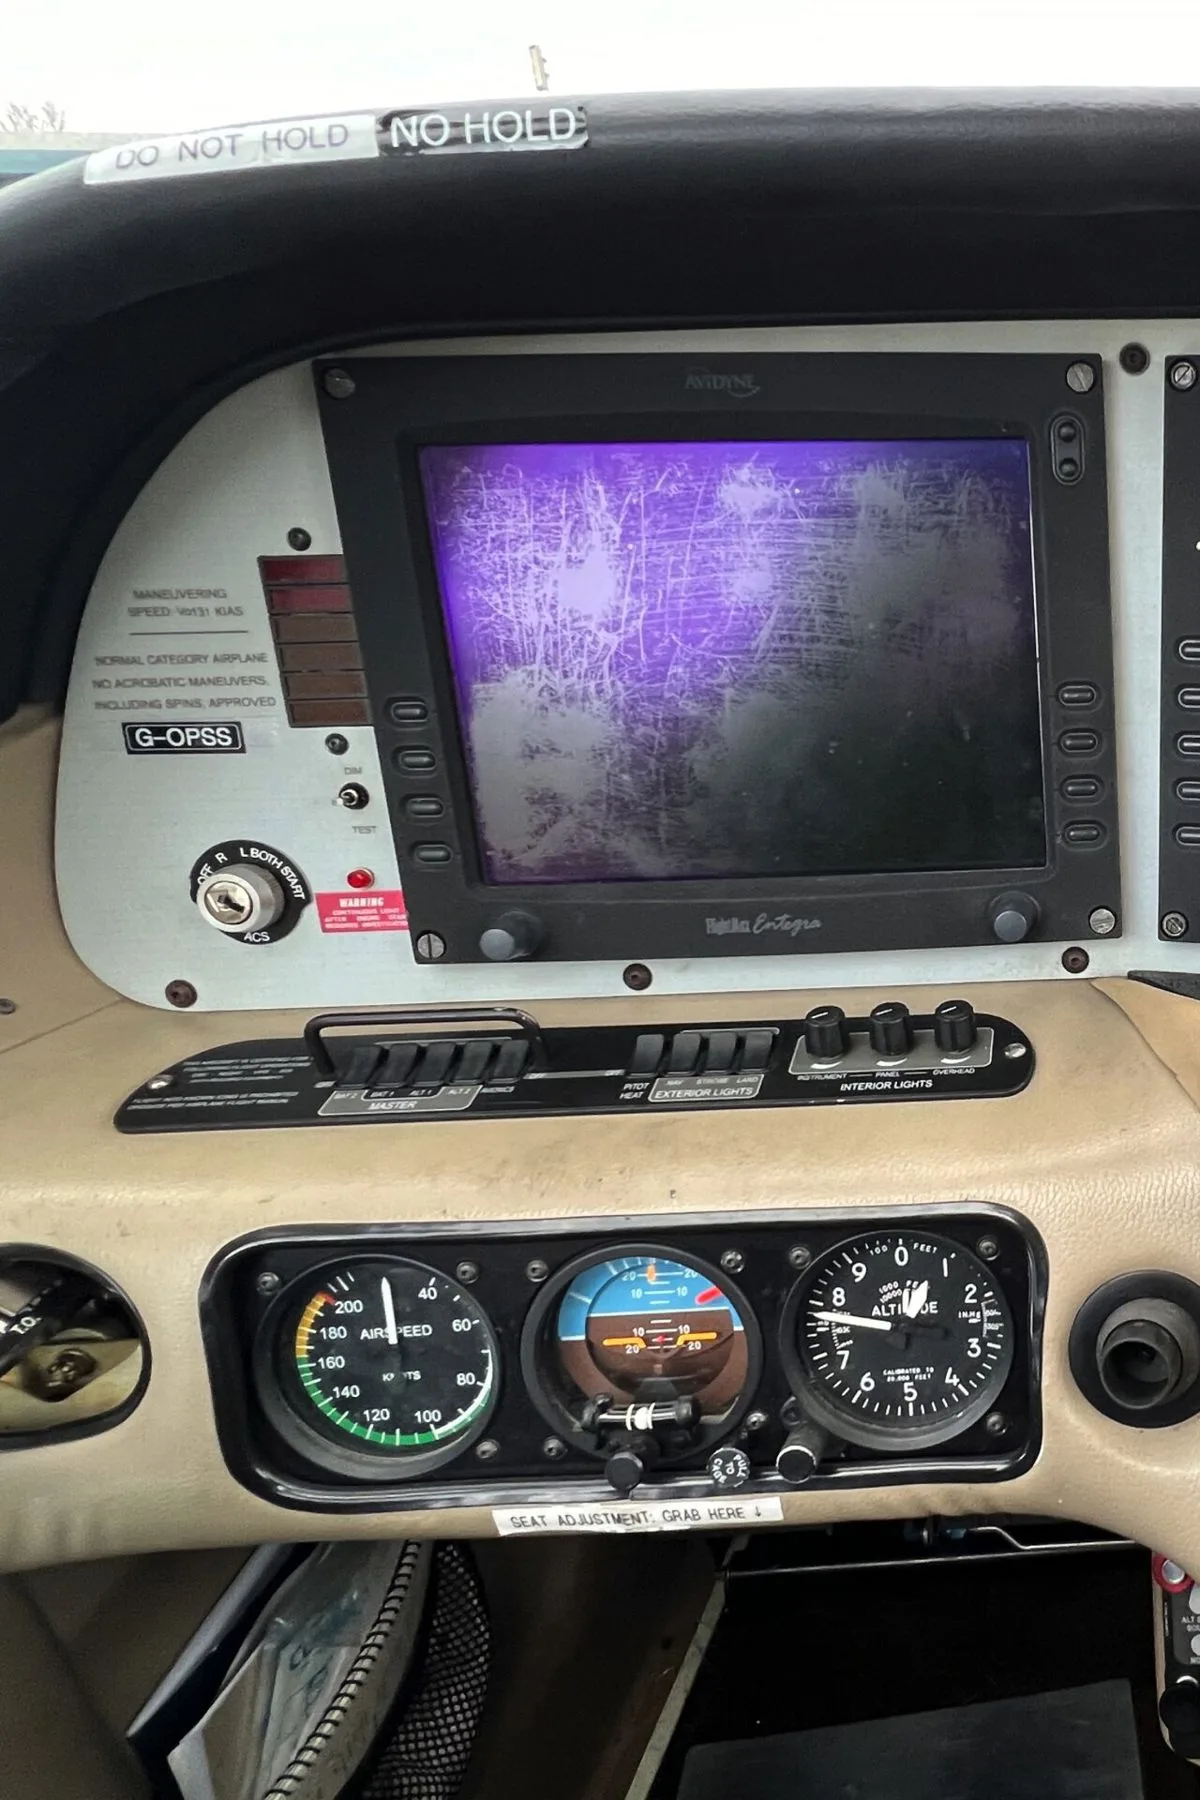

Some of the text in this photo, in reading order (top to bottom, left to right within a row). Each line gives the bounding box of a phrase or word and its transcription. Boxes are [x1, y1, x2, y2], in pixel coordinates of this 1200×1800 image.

[390, 108, 577, 147] NO HOLD
[116, 124, 349, 170] DO NOT HOLD
[685, 374, 755, 390] AVIDYNE
[133, 589, 228, 599] MANEUVERING
[215, 606, 244, 616] KIAS
[94, 653, 268, 666] NORMAL CATEGORY AIRPLANE
[92, 679, 112, 689] NO
[115, 678, 185, 688] ACROBATIC
[94, 700, 162, 710] INCLUDING
[209, 697, 276, 707] APPROVED
[135, 727, 232, 747] G-OPSS
[352, 825, 377, 834] TEST
[250, 847, 283, 870] BOTH
[280, 865, 306, 900] START
[339, 897, 384, 907] WARNING
[244, 931, 270, 942] ACS
[797, 1073, 847, 1081] INSTRUMENT
[840, 1079, 933, 1091] INTERIOR LIGHTS
[619, 1092, 644, 1100] HEAT
[655, 1087, 754, 1099] EXTERIOR LIGHTS
[368, 1101, 418, 1110] MASTER
[913, 1243, 938, 1254] FEET
[894, 1246, 909, 1266] 0
[851, 1263, 867, 1283] 9
[418, 1287, 438, 1300] 40
[832, 1287, 846, 1307] 8
[964, 1283, 978, 1304] 2
[335, 1300, 364, 1314] 200
[452, 1319, 472, 1332] 60
[320, 1326, 347, 1339] 180
[625, 1341, 702, 1354] 20 20
[967, 1338, 981, 1358] 3
[318, 1356, 345, 1369] 160
[837, 1350, 850, 1370] 7
[456, 1373, 476, 1386] 80
[860, 1372, 875, 1392] 6
[945, 1367, 960, 1386] 4
[333, 1386, 360, 1398] 140
[904, 1381, 918, 1401] 5
[364, 1408, 390, 1421] 120
[414, 1410, 442, 1422] 100
[510, 1507, 745, 1528] SEAT ADJUSTMENT: GRAB HERE
